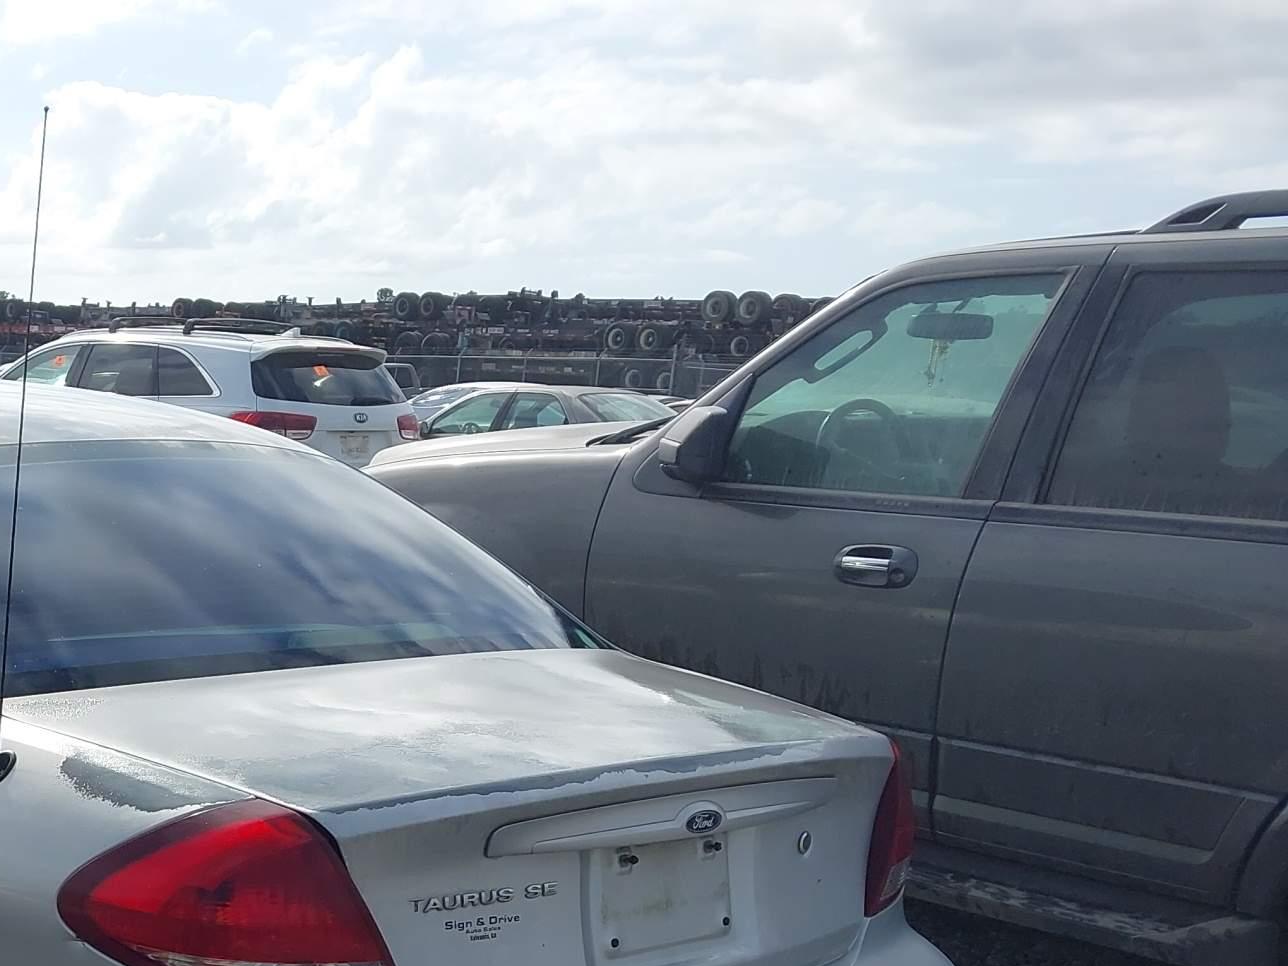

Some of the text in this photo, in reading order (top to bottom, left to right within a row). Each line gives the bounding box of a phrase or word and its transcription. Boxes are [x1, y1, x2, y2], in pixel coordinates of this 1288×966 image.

[408, 881, 559, 913] TAURUS SE
[444, 915, 520, 931] Sign & Drive
